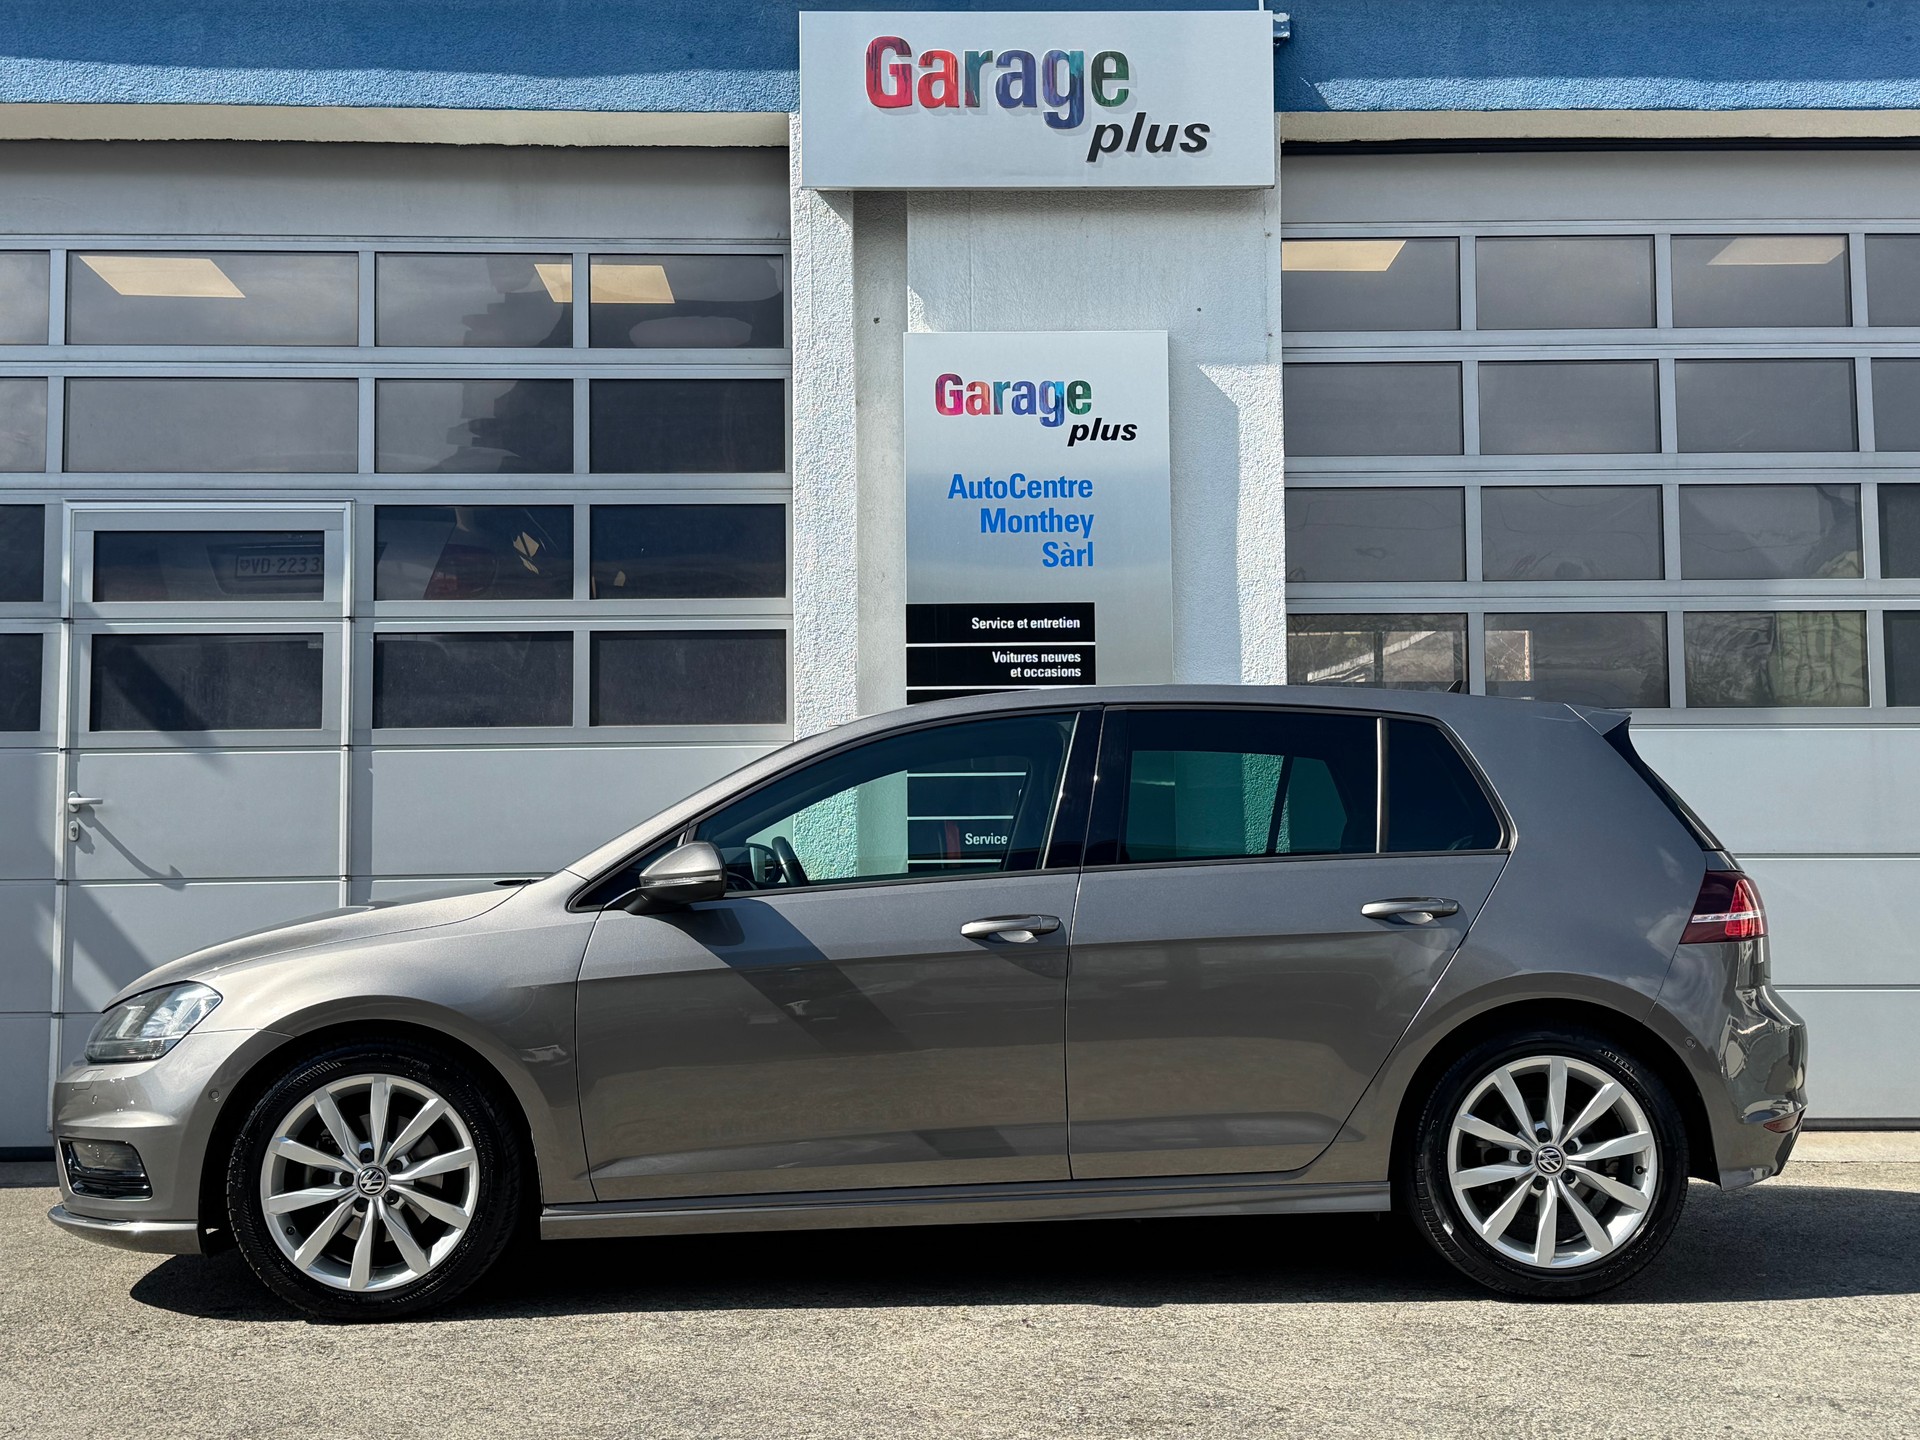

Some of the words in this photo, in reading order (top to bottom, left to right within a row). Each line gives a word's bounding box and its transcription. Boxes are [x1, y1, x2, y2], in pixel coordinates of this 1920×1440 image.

[865, 35, 1130, 129] Garage
[1085, 112, 1211, 162] plus
[934, 373, 1092, 427] Garage
[1067, 417, 1138, 447] plus
[947, 473, 1093, 499] AutoCentre
[980, 507, 1095, 539] Monthey
[1042, 541, 1094, 567] Sàrl
[971, 616, 1015, 630] Service
[1016, 618, 1028, 629] et
[1030, 616, 1081, 629] entretien
[991, 650, 1039, 663] Voitures
[1041, 652, 1081, 663] neuves
[1010, 666, 1022, 678] et
[1023, 665, 1082, 678] occasions
[965, 832, 1008, 845] Service
